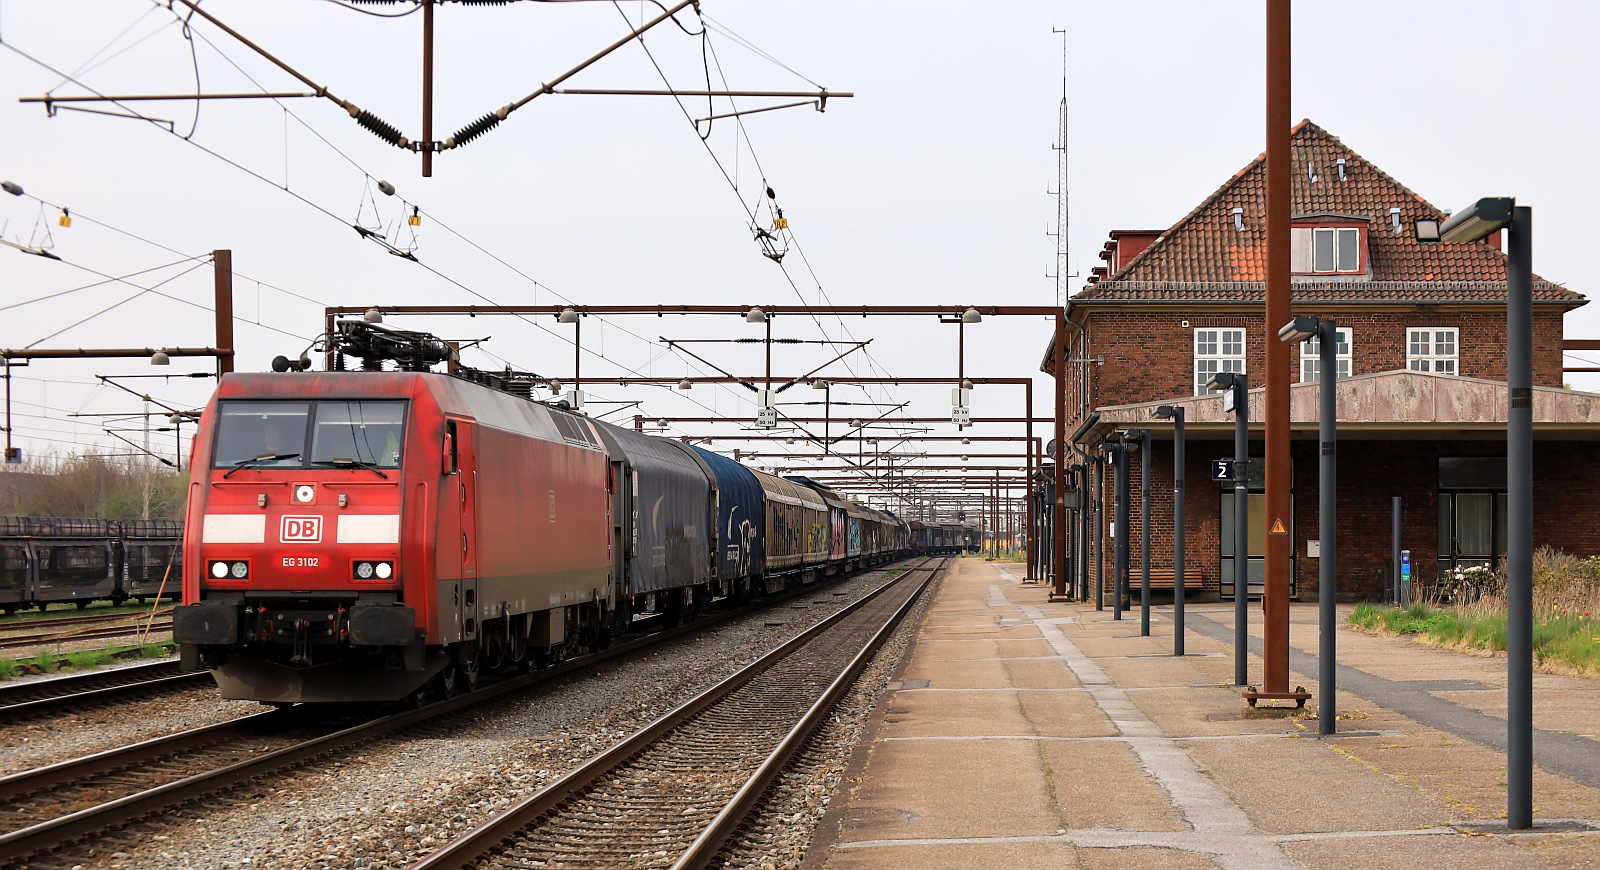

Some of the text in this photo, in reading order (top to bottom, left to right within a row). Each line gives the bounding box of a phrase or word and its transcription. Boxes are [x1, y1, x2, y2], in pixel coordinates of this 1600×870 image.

[1217, 466, 1227, 477] 2
[287, 521, 315, 537] DB
[282, 557, 319, 567] EG 3102
